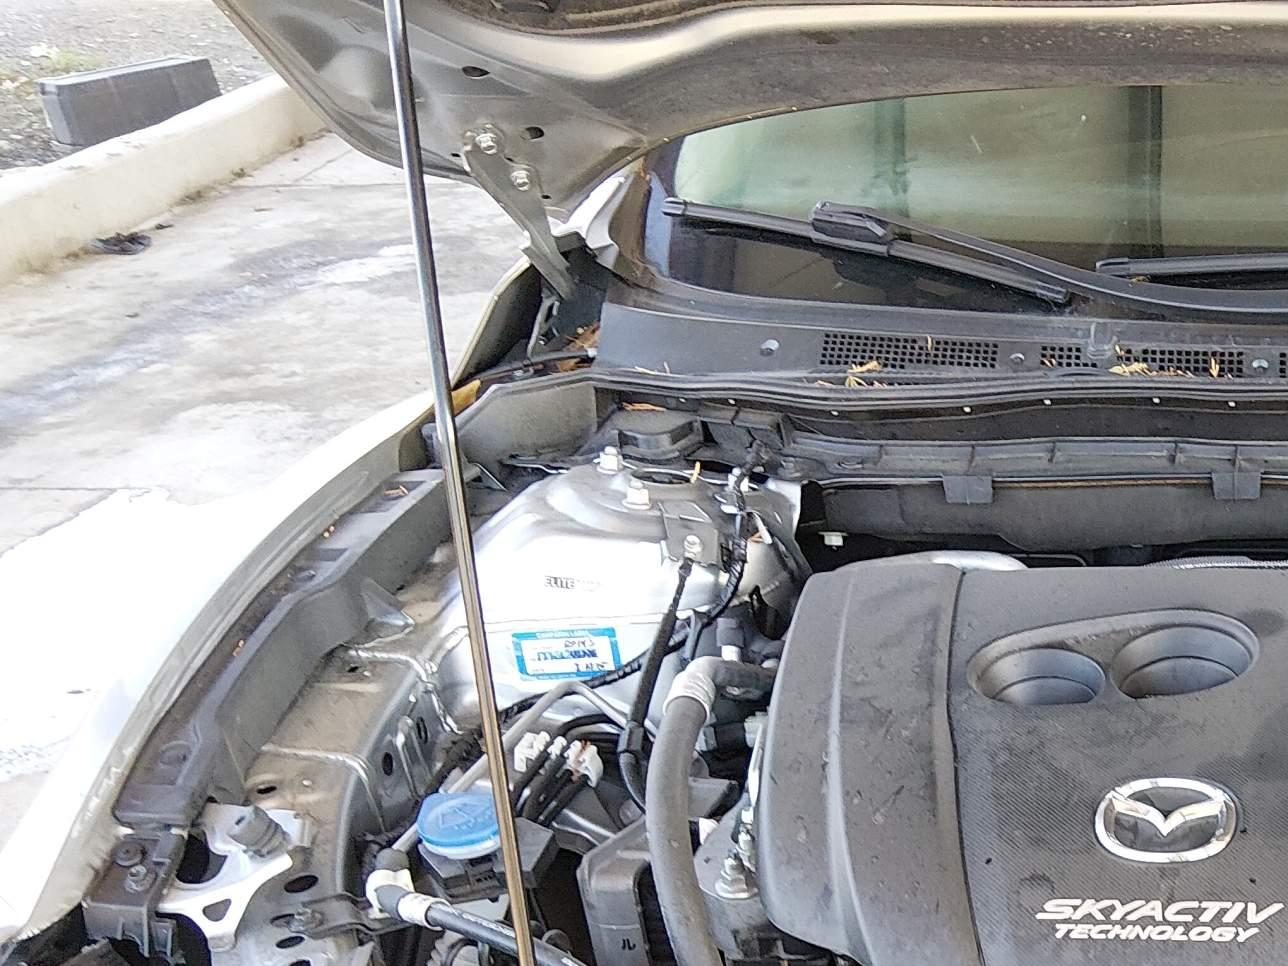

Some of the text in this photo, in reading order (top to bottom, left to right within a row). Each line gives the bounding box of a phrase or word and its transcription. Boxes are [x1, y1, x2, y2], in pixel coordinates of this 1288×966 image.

[544, 575, 575, 589] ELITE
[1035, 898, 1285, 924] SKYACTIV
[1055, 923, 1260, 943] TECHNOLOGY
